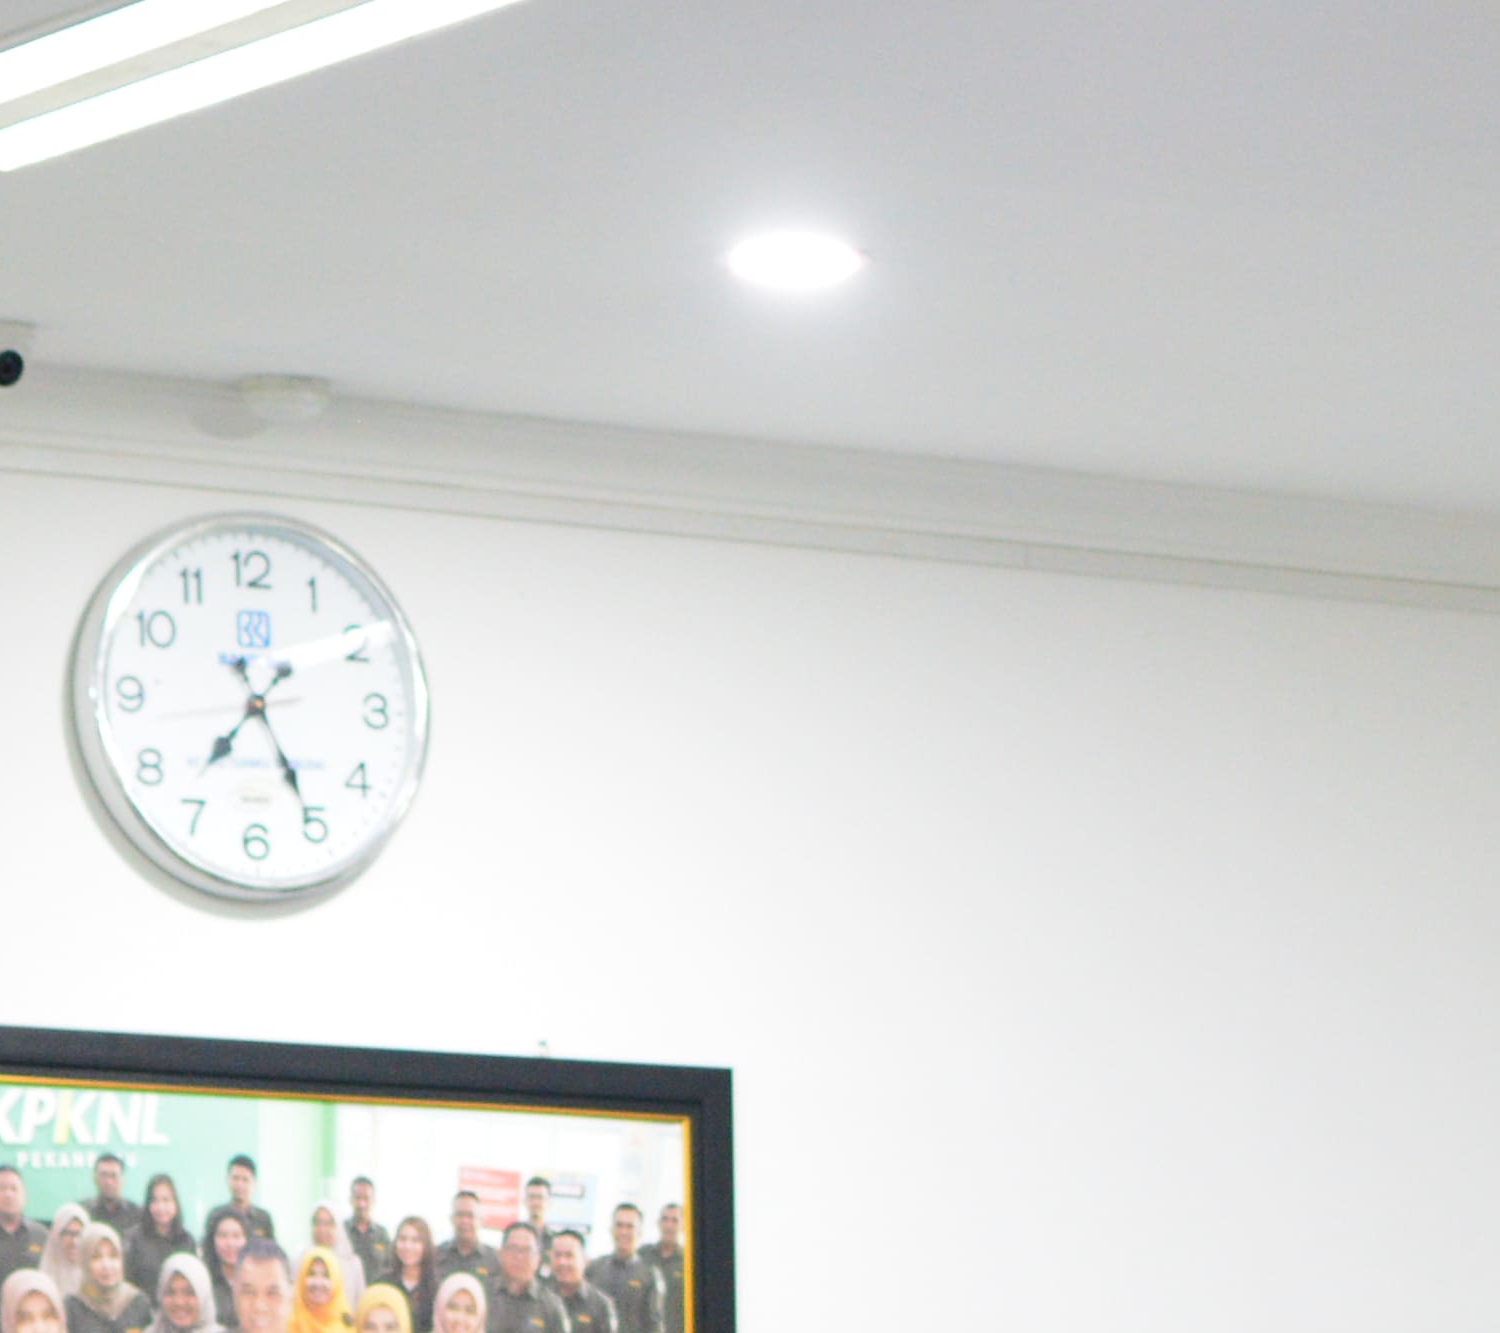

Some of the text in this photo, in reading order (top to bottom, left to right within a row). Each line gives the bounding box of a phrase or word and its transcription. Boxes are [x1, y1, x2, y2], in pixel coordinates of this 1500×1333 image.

[180, 567, 203, 605] 11
[232, 550, 272, 590] 12
[307, 576, 318, 613] 1
[135, 610, 177, 649] 10
[342, 623, 371, 663] 2
[116, 675, 145, 712] 9
[363, 693, 390, 730] 3
[136, 747, 164, 786] 8
[344, 761, 371, 798] 4
[180, 799, 206, 836] 7
[303, 806, 328, 843] 5
[243, 823, 270, 861] 6
